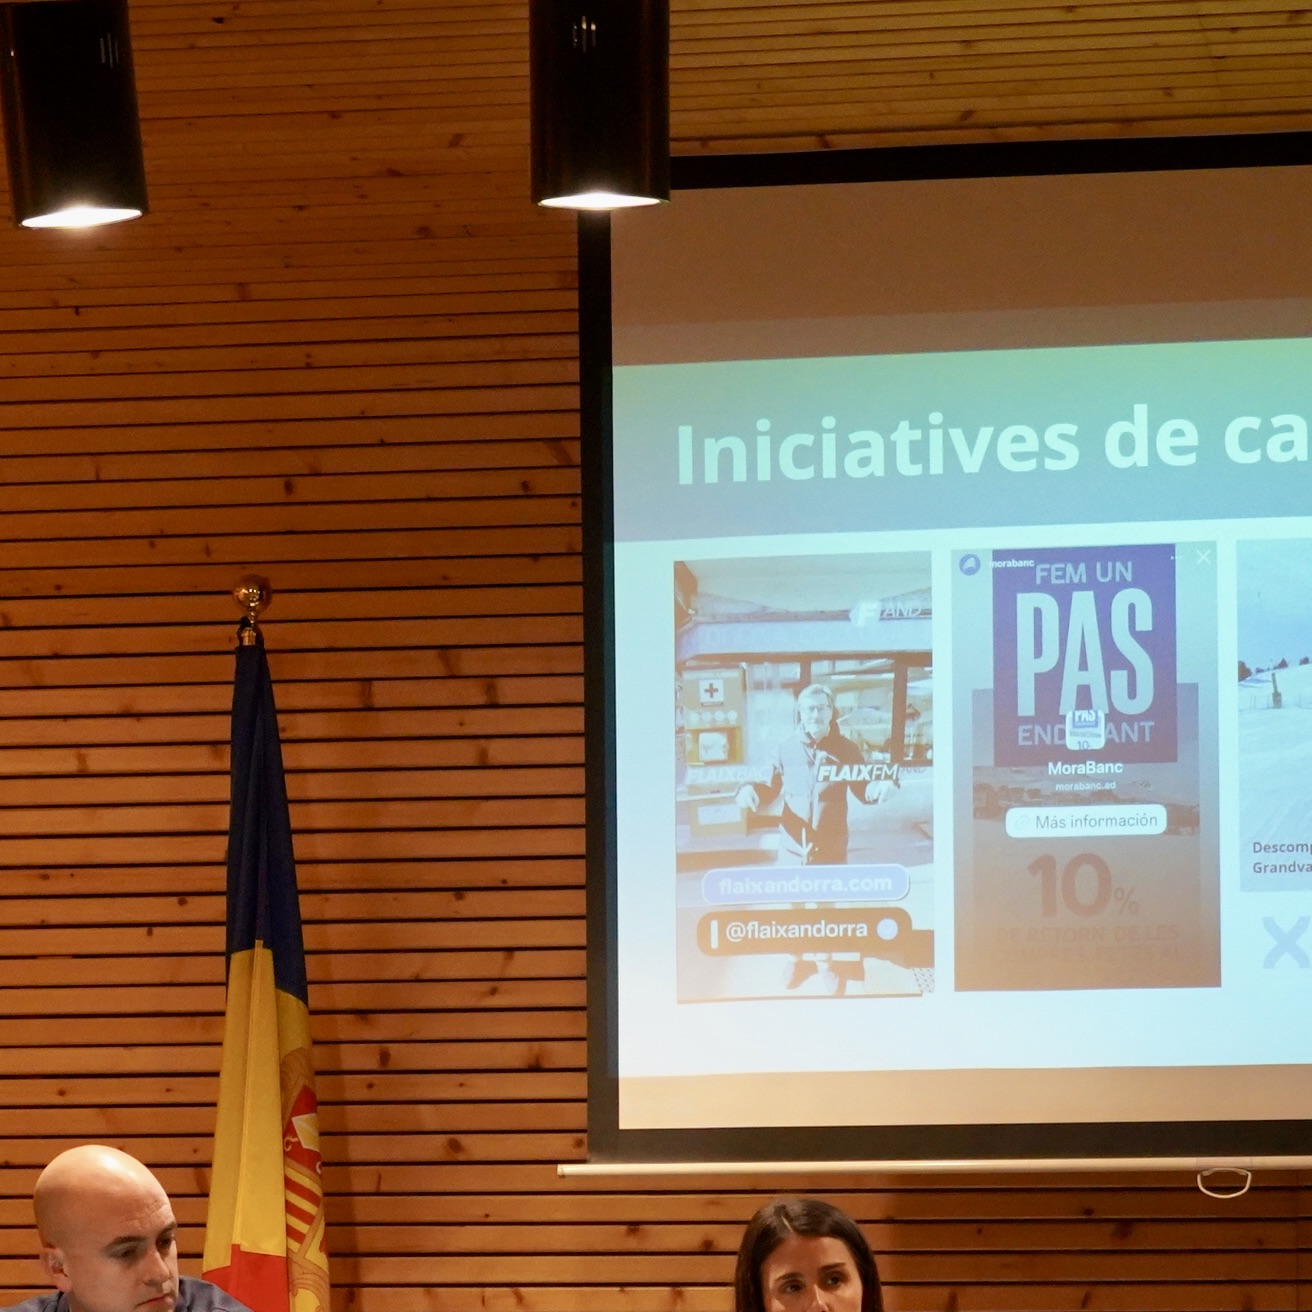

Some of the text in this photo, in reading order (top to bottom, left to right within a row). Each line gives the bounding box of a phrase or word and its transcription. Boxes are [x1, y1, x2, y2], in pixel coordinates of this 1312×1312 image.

[678, 411, 1079, 485] Iniciatives
[1104, 403, 1199, 468] de
[1036, 561, 1133, 585] FEM UN
[1016, 588, 1155, 717] PAS
[1018, 721, 1155, 746] ENDANT
[818, 763, 900, 782] FLAIXFM
[1047, 761, 1123, 775] MoraBanc
[1055, 780, 1117, 791] morabanc.ad
[1035, 812, 1158, 829] Más información
[719, 875, 892, 896] flaixandorra.com
[1027, 853, 1139, 920] 10%
[726, 919, 868, 942] @flaixandorra
